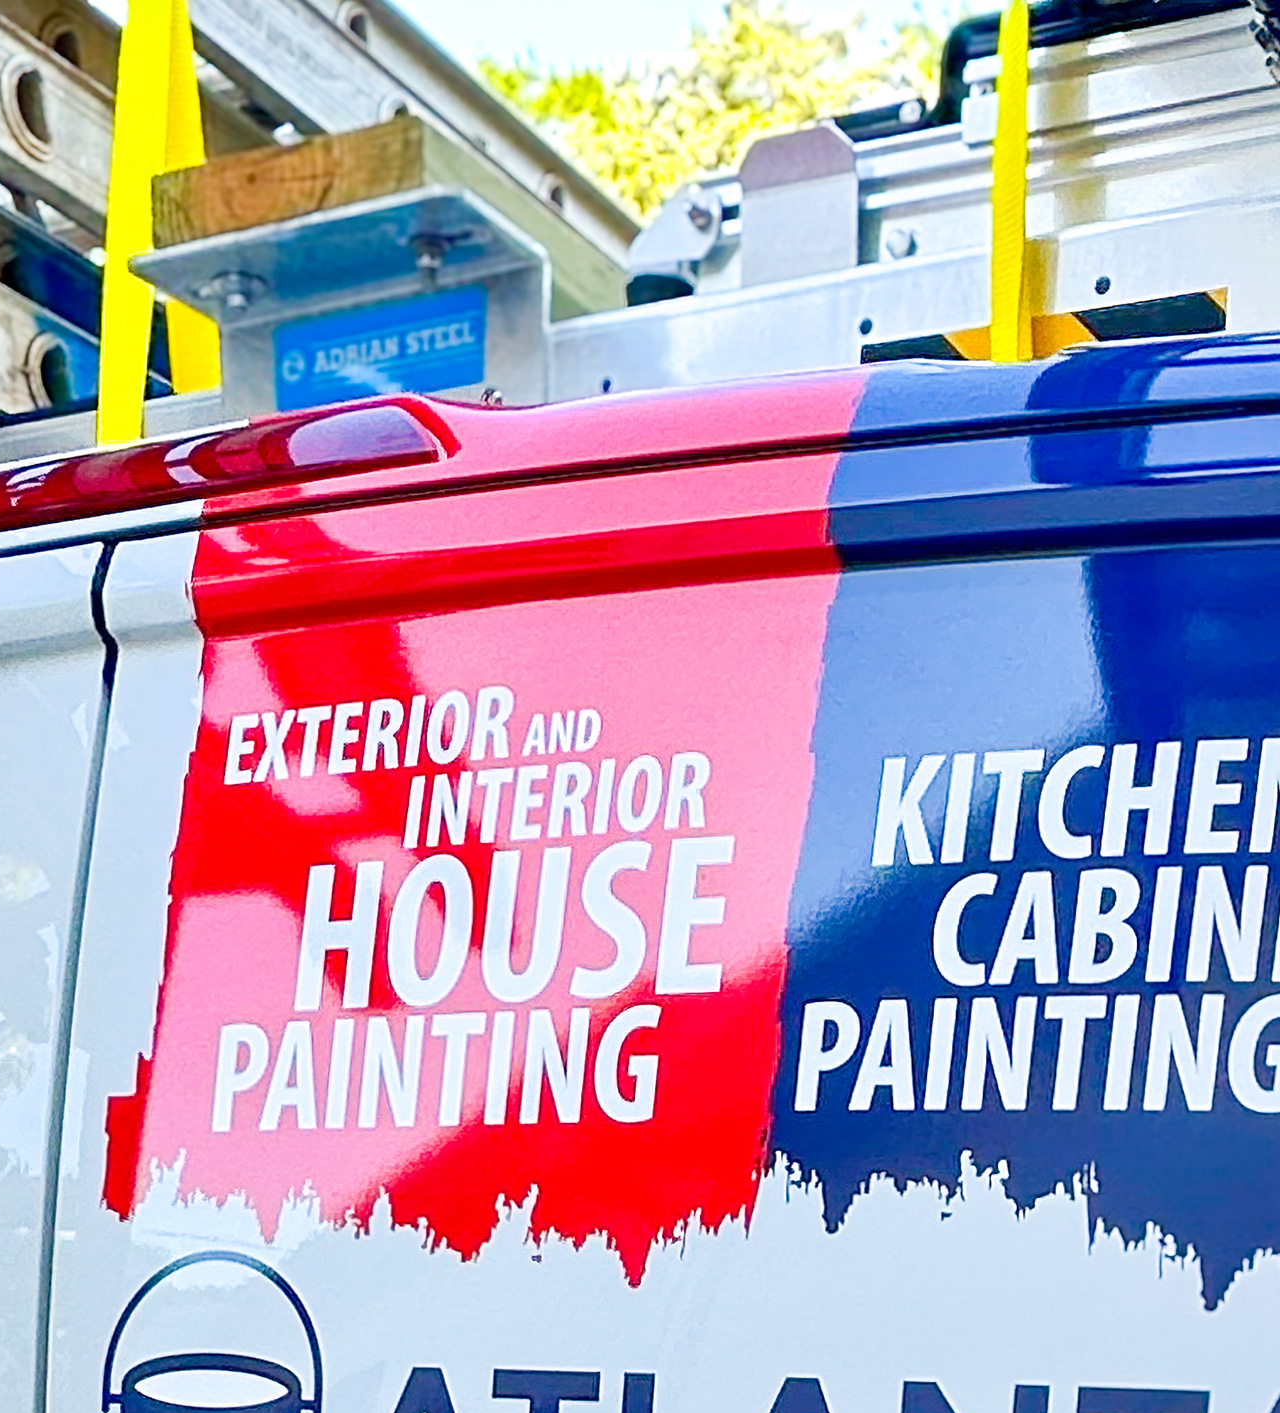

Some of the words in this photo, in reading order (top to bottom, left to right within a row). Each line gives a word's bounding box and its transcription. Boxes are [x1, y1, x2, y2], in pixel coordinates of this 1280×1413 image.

[314, 336, 400, 373] ADRIAN
[406, 322, 476, 355] STEEL
[223, 685, 516, 786] EXTERIOR
[523, 708, 603, 757] AND
[402, 751, 712, 849] INTERIOR
[293, 836, 736, 1012] HOUSE
[210, 1004, 663, 1133] PAINTING
